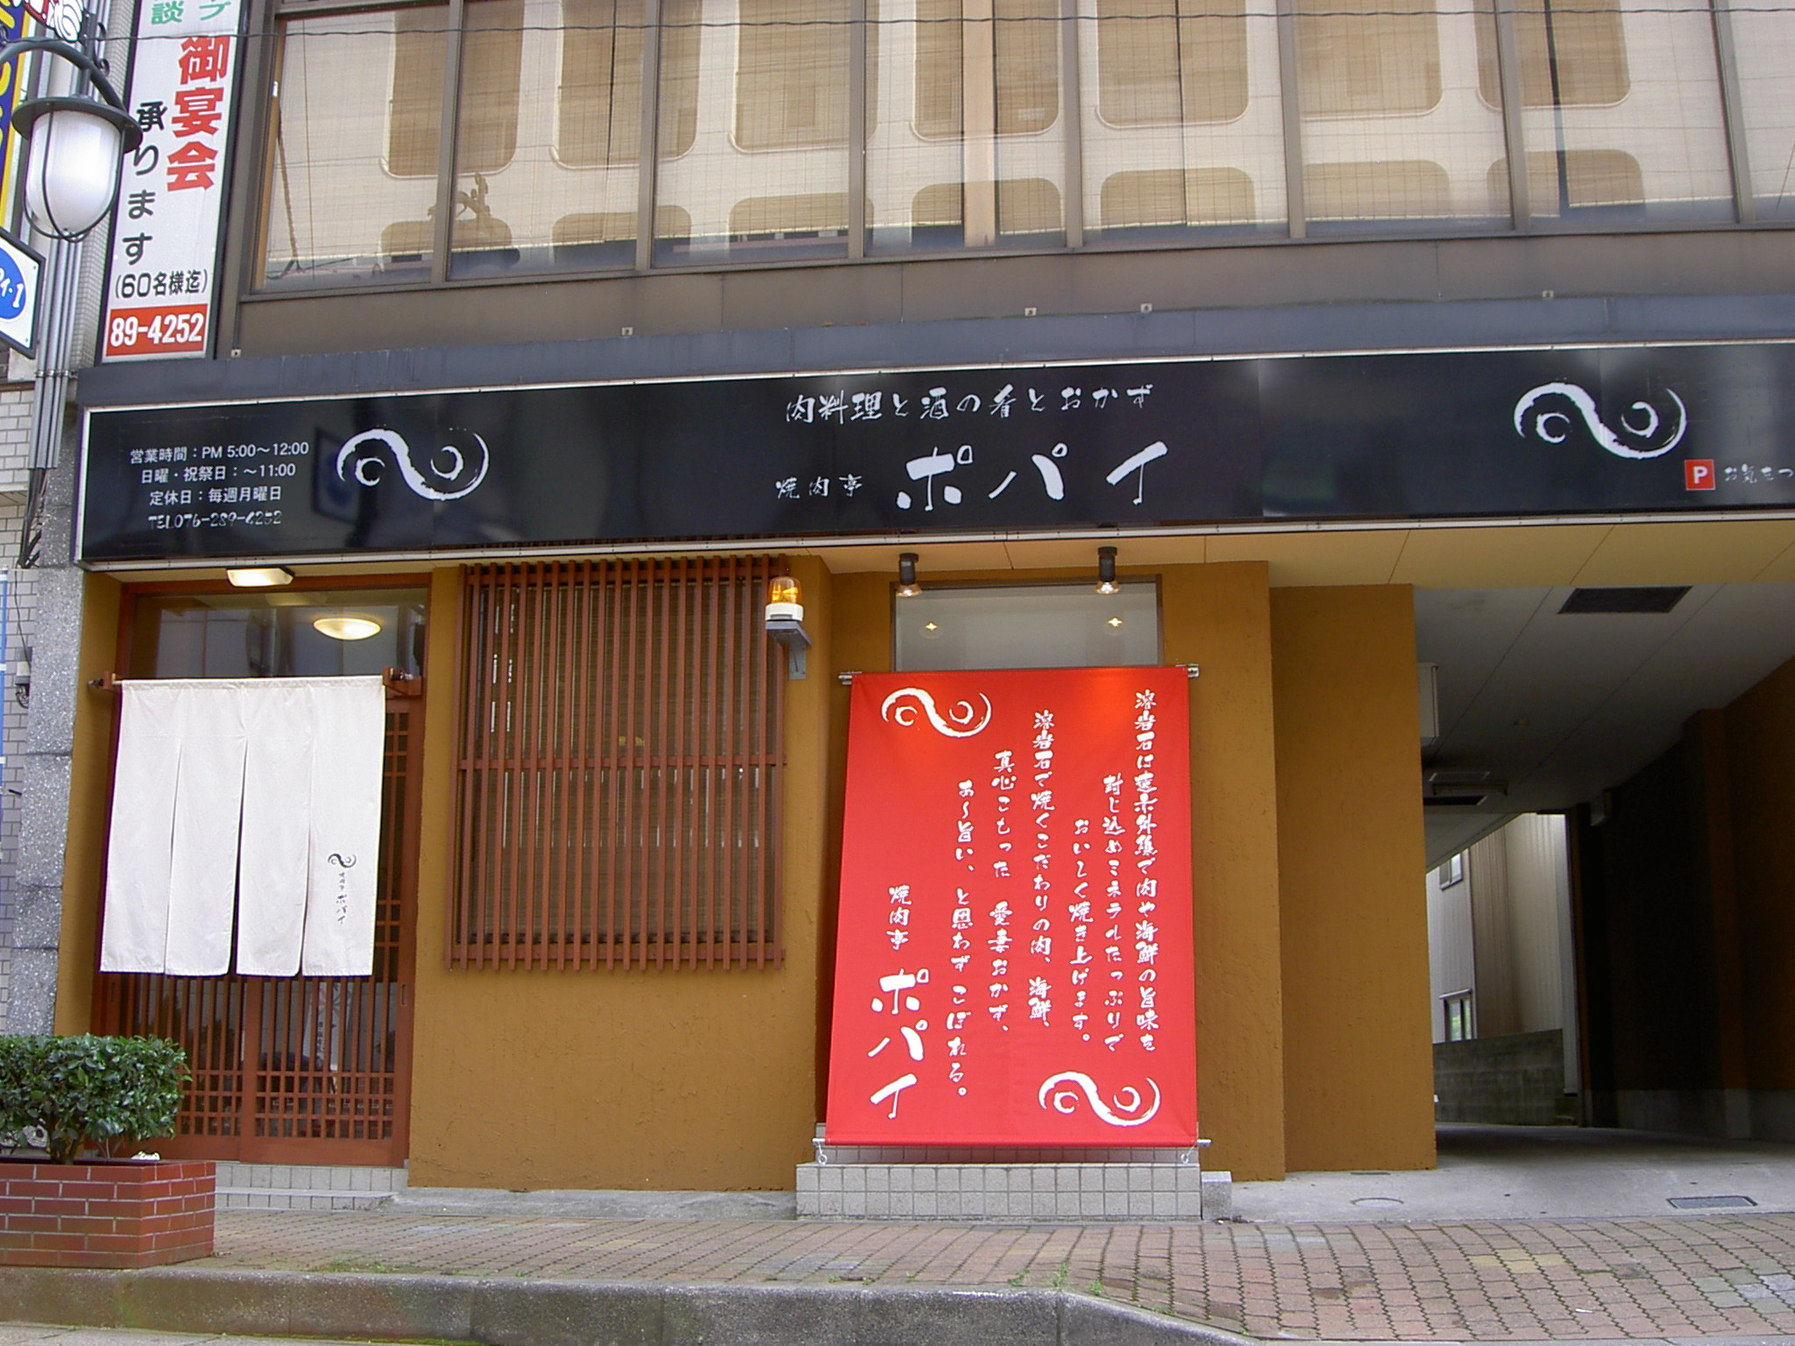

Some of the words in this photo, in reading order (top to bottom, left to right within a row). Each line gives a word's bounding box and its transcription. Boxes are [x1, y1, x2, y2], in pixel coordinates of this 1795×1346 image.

[167, 35, 232, 192] 御宴会
[123, 101, 168, 265] 承ります
[110, 312, 205, 348] 89-4252
[786, 383, 1154, 425] 肉料理と酒の肴とおかず
[776, 474, 863, 499] 焼肉亭
[896, 442, 1169, 511] ポパイ
[1693, 465, 1709, 485] P
[886, 884, 913, 950] 焼肉亭
[867, 968, 930, 1120] ポパイ
